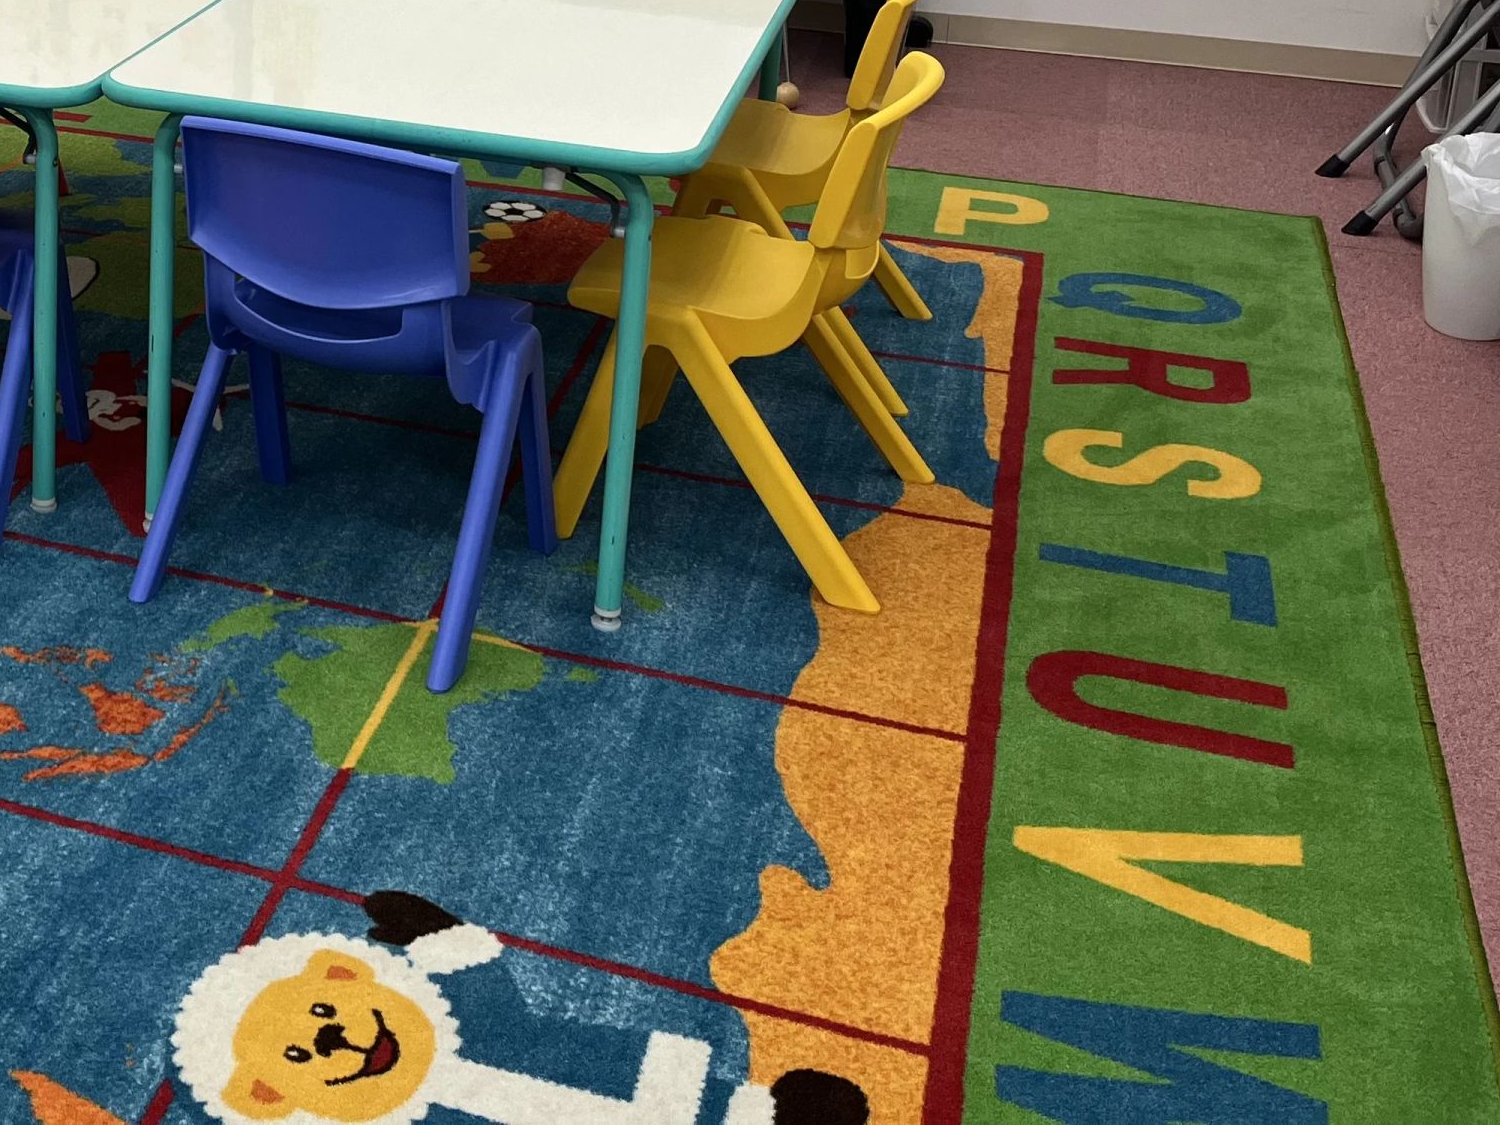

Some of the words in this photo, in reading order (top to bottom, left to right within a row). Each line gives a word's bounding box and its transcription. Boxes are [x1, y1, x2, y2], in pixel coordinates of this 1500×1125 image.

[932, 186, 1049, 236] P
[1047, 272, 1242, 325] Q
[1052, 336, 1252, 405] R
[1043, 428, 1262, 500] S
[1037, 543, 1278, 627] T
[1025, 650, 1295, 769] U
[1012, 825, 1312, 965] V
